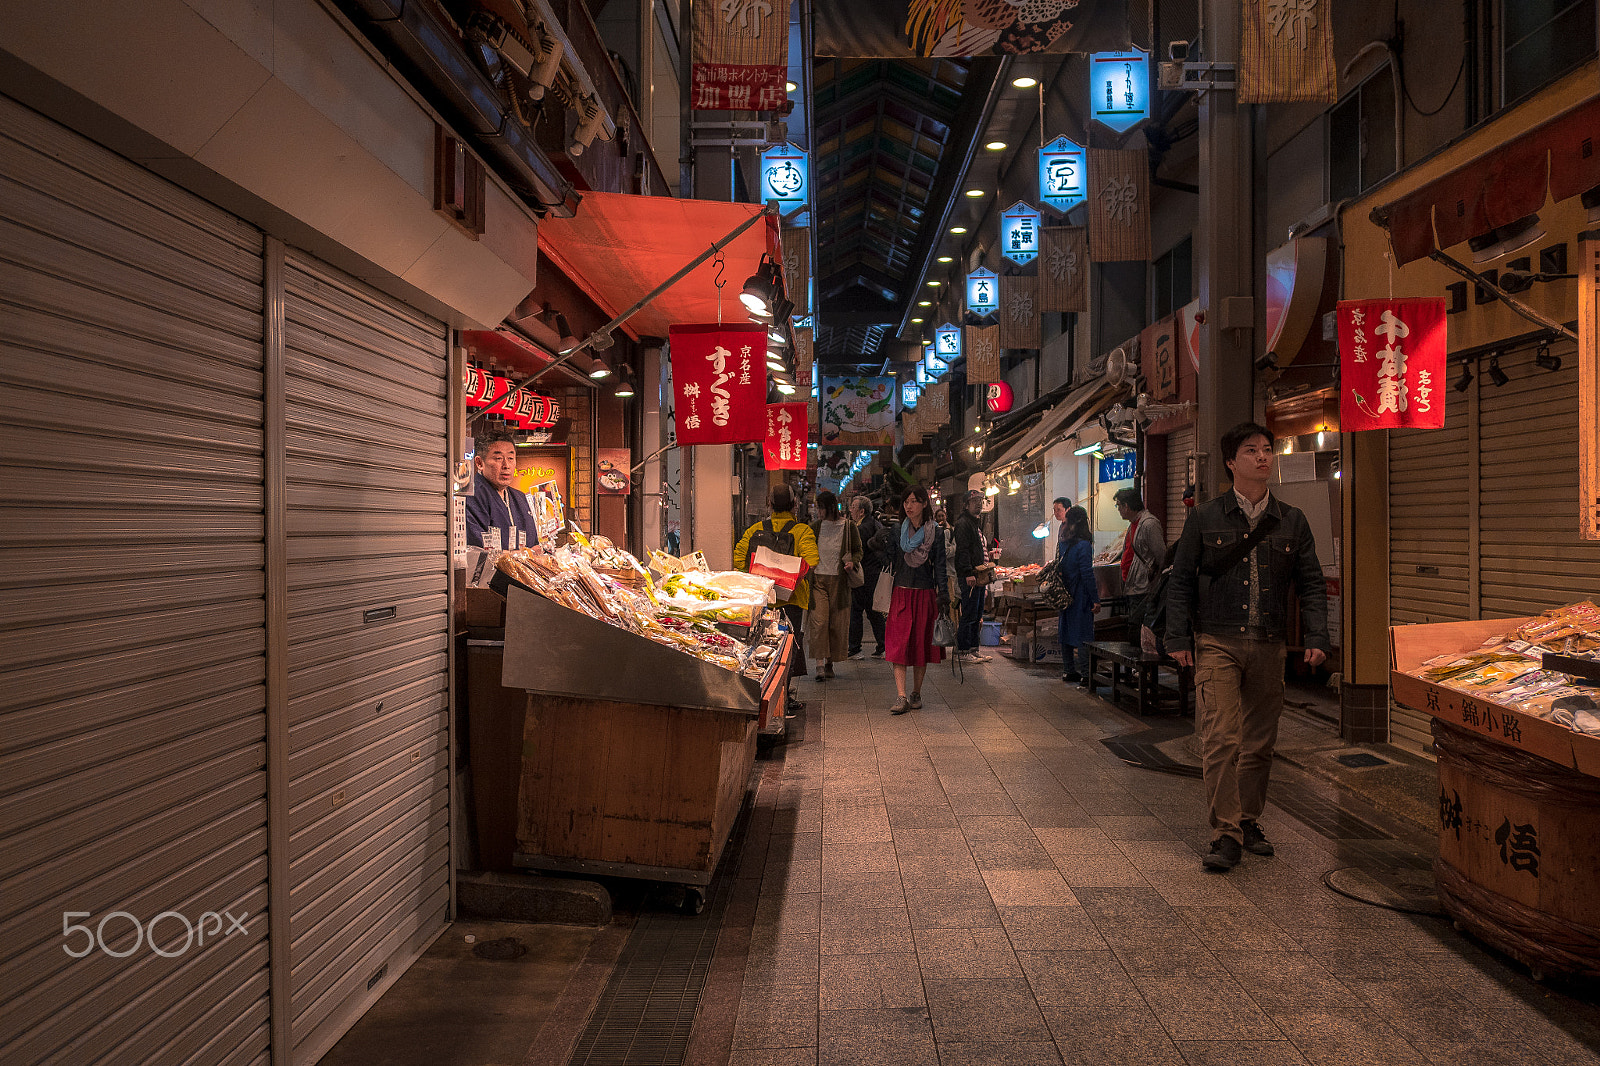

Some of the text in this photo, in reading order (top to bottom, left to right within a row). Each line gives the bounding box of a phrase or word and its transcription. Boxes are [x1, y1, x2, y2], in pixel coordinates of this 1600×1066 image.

[696, 66, 784, 84] 錦市場ポイントカード
[695, 83, 784, 110] 加盟店
[1098, 175, 1139, 228] 錦
[1044, 245, 1078, 287] 錦
[977, 280, 989, 304] 大島
[1006, 291, 1035, 327] 錦
[738, 344, 752, 385] 京名産
[705, 345, 736, 427] すぐき
[1425, 687, 1522, 743] 京・錦小路
[1494, 815, 1541, 879] 悟
